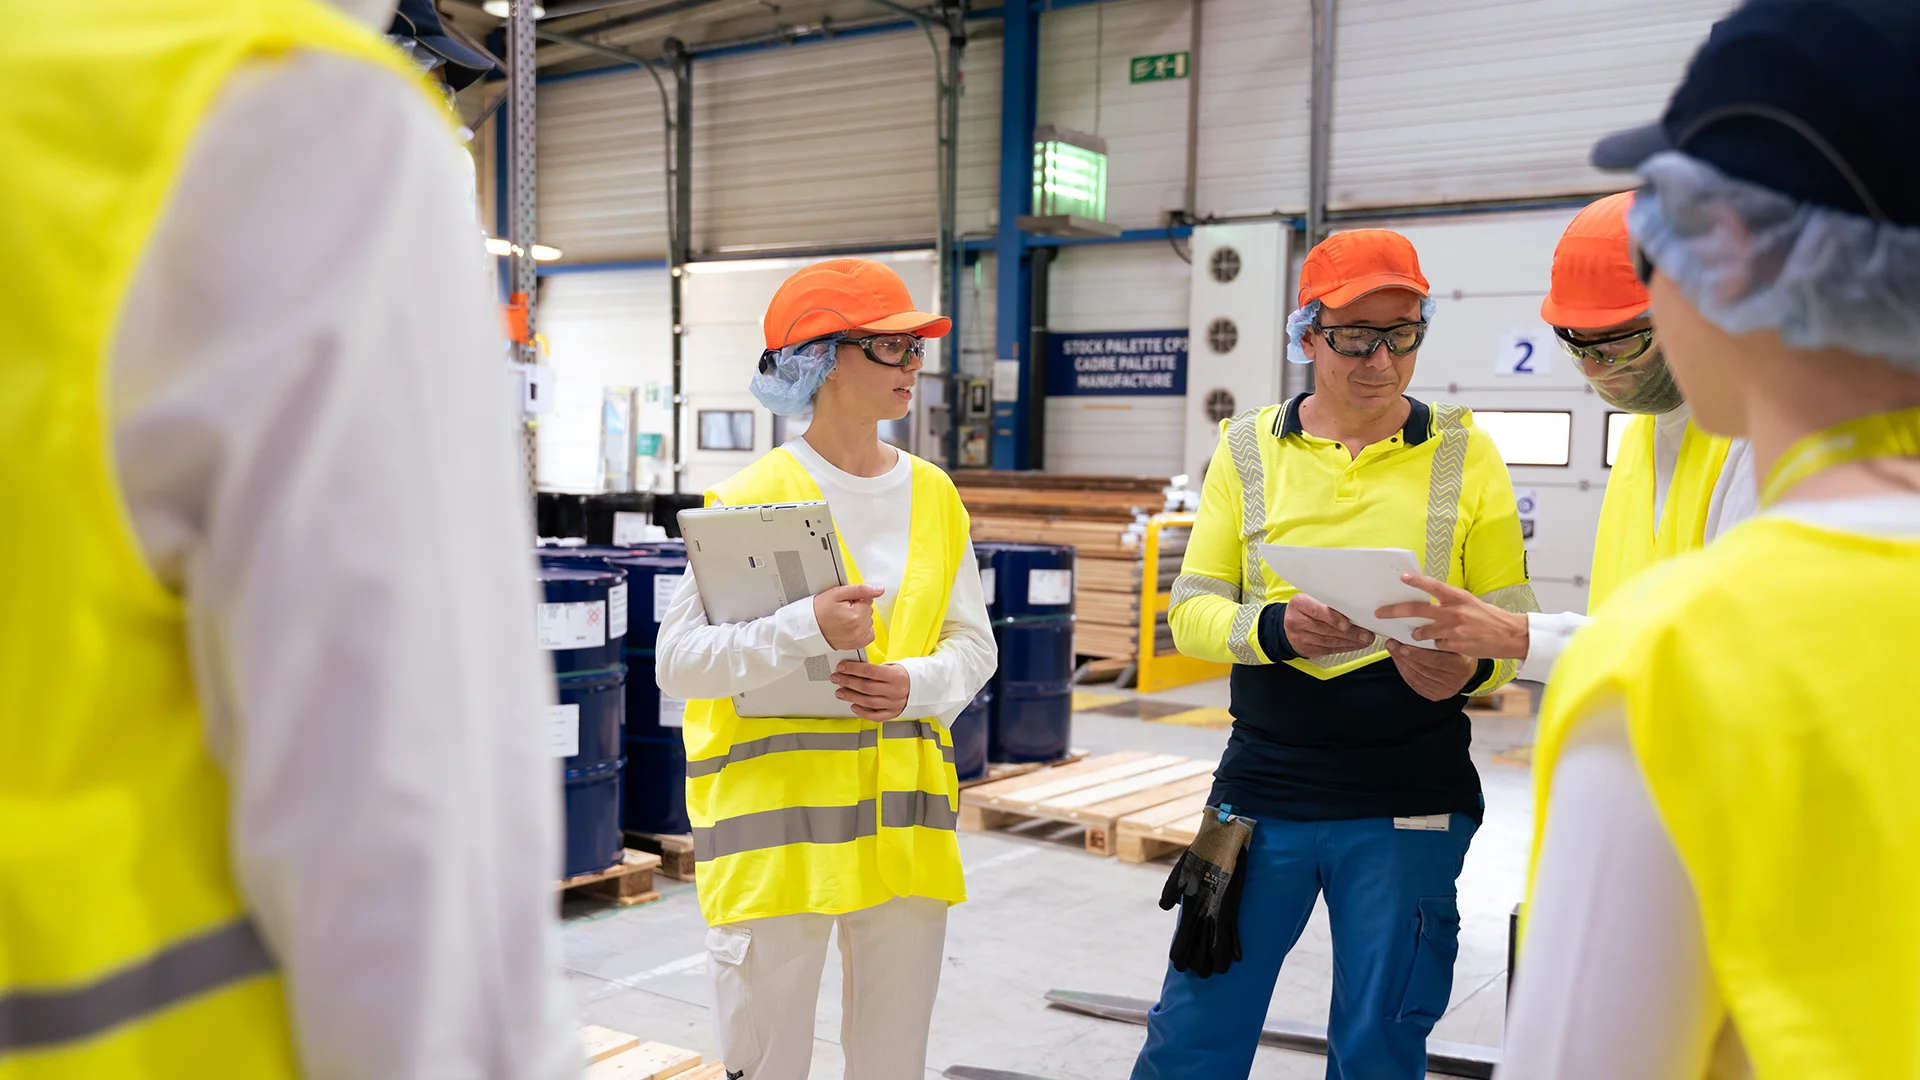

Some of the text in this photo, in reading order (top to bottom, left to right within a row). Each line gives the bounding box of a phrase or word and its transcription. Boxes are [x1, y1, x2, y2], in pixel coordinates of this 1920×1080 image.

[1062, 339, 1104, 355] STOCK
[1105, 337, 1162, 353] PALETTE
[1074, 354, 1177, 371] CADRE PALETTE
[1514, 342, 1533, 372] 2
[1077, 372, 1173, 388] MANUFACTURE
